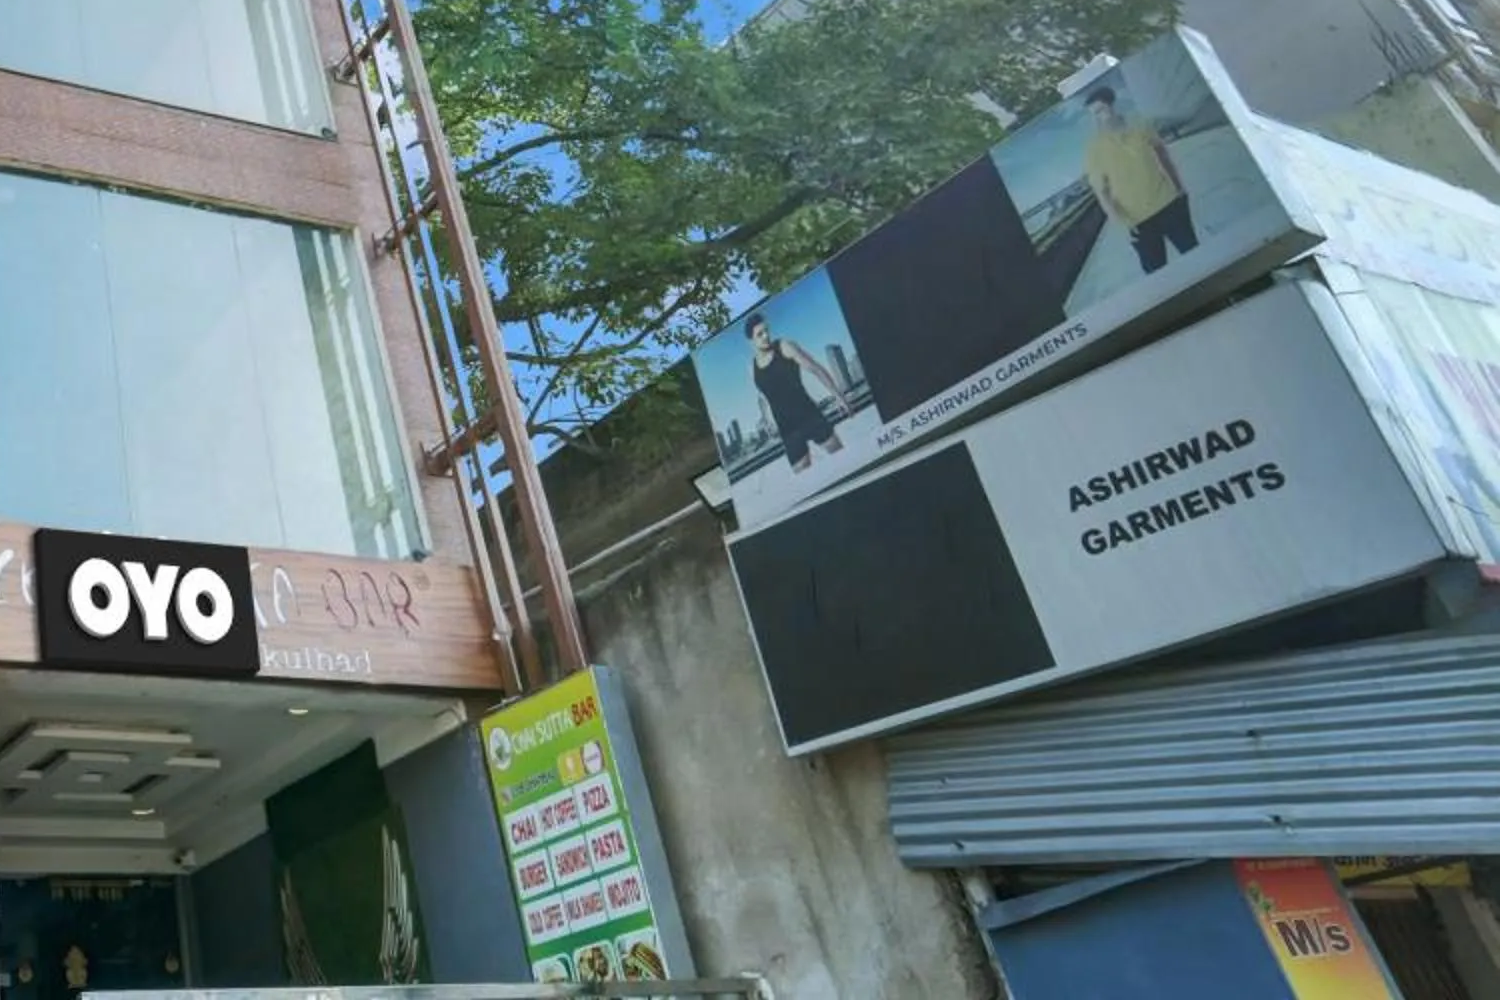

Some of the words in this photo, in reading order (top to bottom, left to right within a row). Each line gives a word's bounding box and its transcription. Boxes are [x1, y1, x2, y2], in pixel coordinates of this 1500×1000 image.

[910, 377, 993, 431] ASHIRWAD
[995, 322, 1088, 382] GARMENTS
[1068, 418, 1256, 513] ASHIRWAD
[1080, 462, 1286, 556] GARMENTS
[68, 557, 235, 645] OYO
[571, 695, 597, 728] BAR
[582, 784, 611, 815] PIZZA
[511, 814, 538, 845] CHAI
[592, 828, 625, 861] PASTA
[1276, 917, 1352, 957] M/s
